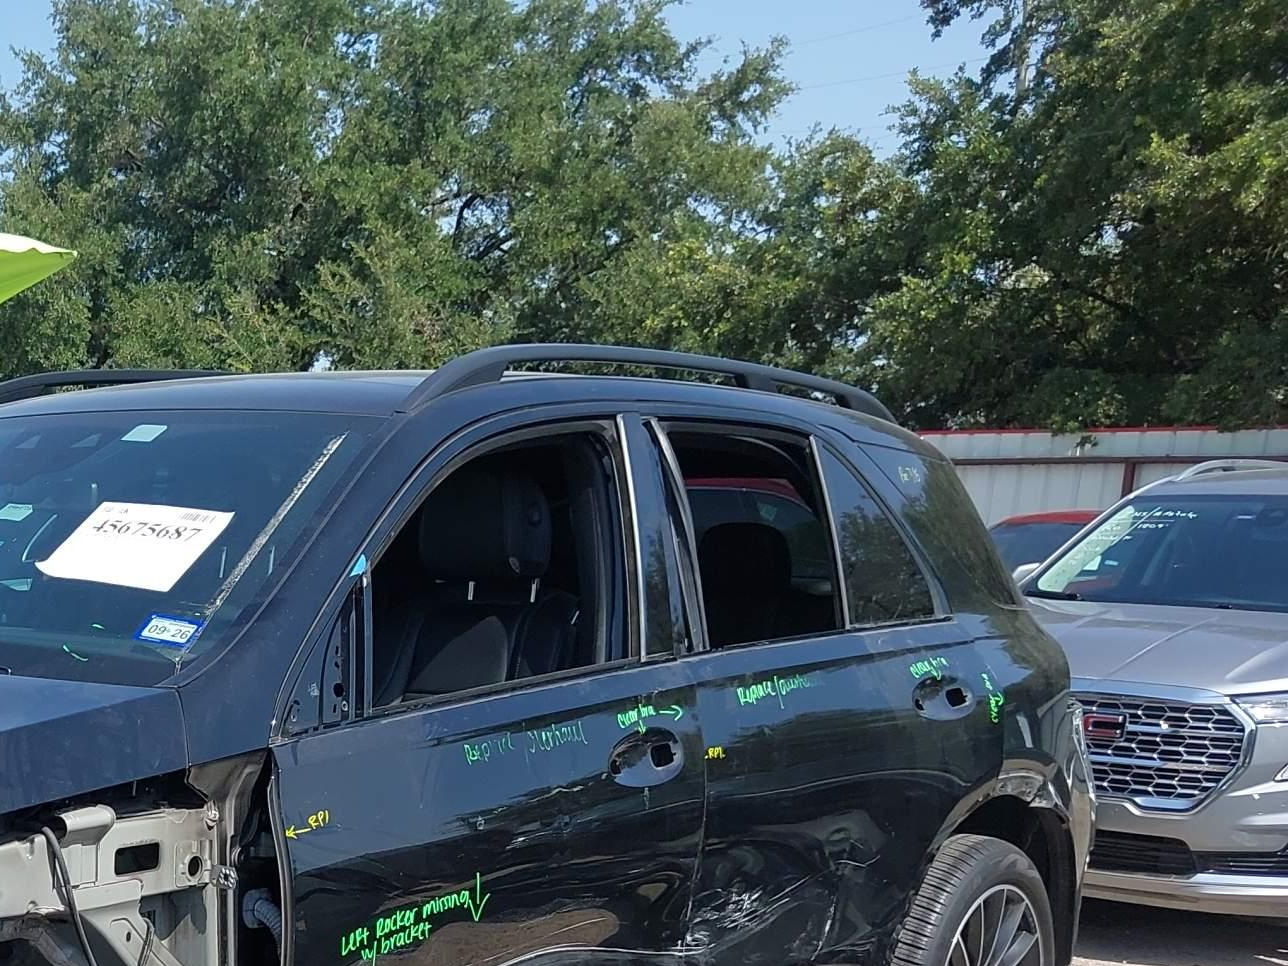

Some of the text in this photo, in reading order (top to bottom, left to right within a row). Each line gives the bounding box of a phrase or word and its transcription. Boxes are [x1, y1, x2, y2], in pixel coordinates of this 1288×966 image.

[93, 519, 203, 541] 45675687
[148, 624, 167, 636] 09
[171, 629, 191, 640] 26
[376, 907, 419, 938] Rocker
[380, 921, 432, 954] bracket
